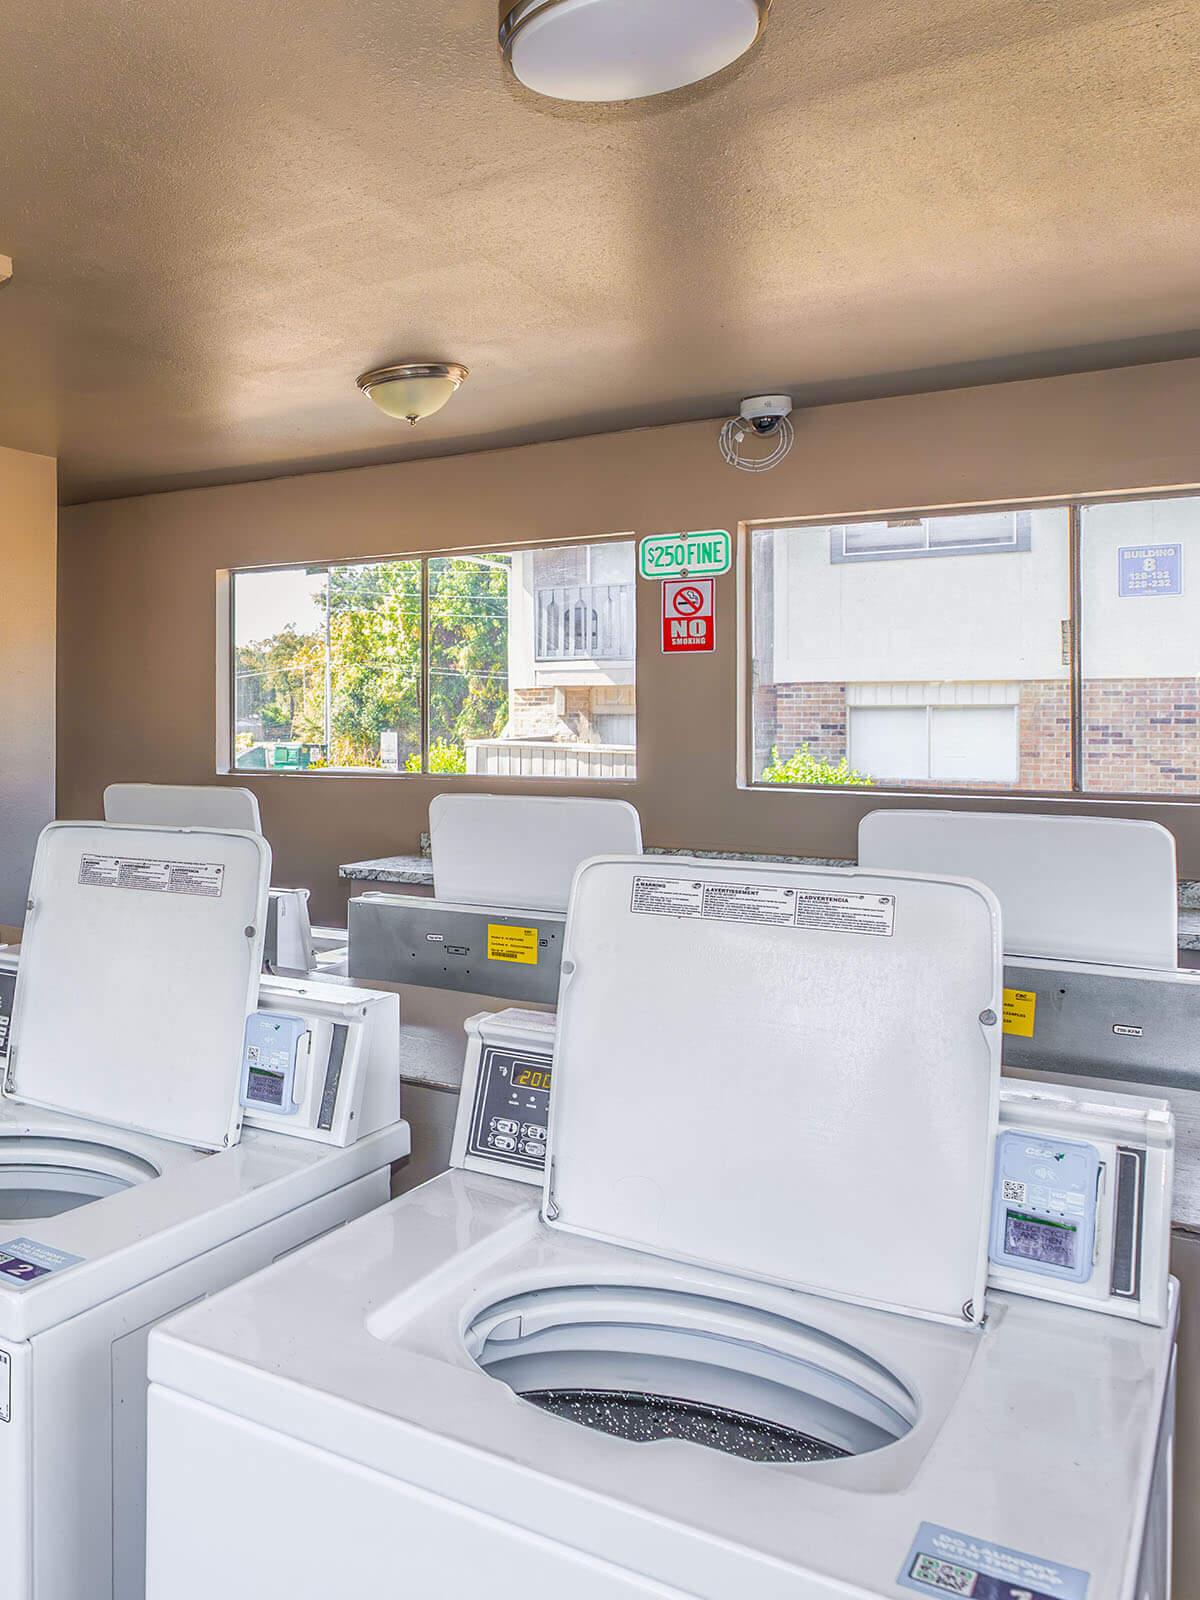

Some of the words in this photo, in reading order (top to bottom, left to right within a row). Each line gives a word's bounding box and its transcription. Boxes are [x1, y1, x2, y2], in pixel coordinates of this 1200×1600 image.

[647, 543, 685, 568] $250
[687, 541, 723, 565] FINE
[1123, 548, 1175, 559] BUILDING
[1143, 558, 1157, 572] 8
[670, 619, 707, 638] NO
[671, 637, 706, 646] SMOKING
[711, 888, 760, 896] AVERTISSEMENT
[804, 895, 849, 903] ADVERTENCIA
[7, 1264, 34, 1276] 2
[931, 1537, 981, 1560] WITH
[983, 1555, 1021, 1573] THE
[1023, 1569, 1065, 1585] APP
[939, 1534, 967, 1548] DO
[968, 1543, 1058, 1576] LAUNDRY
